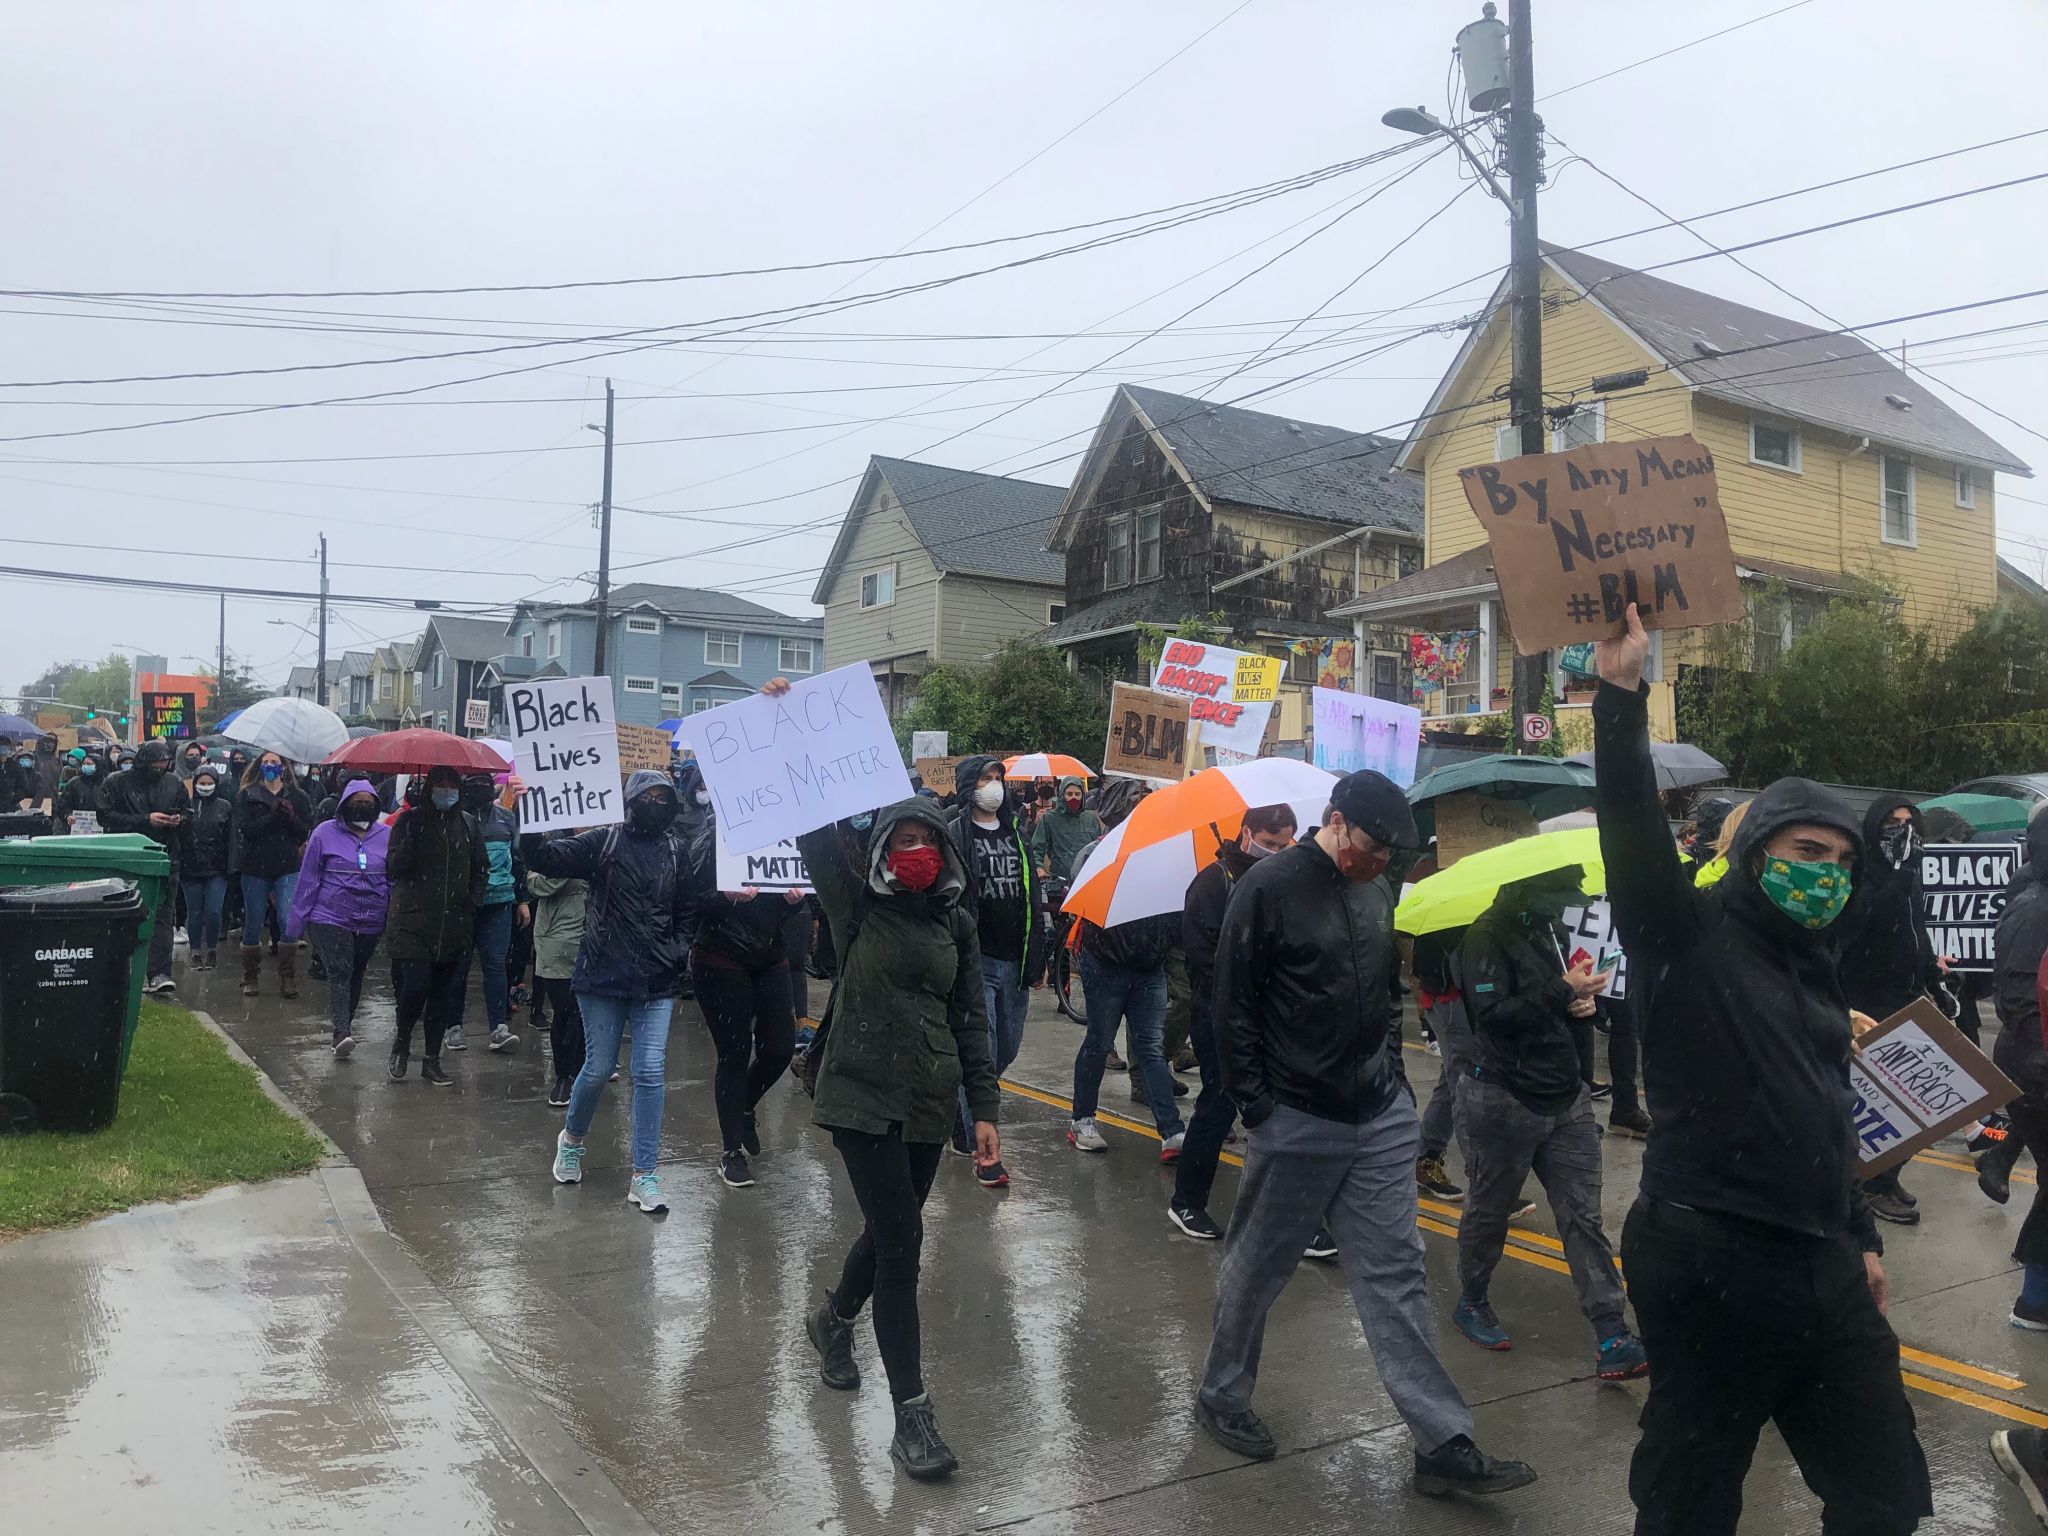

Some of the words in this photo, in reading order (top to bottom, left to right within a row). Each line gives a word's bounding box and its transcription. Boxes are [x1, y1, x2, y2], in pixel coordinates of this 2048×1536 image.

[1567, 460, 1629, 495] Any
[1567, 562, 1689, 624] #BLM
[1164, 641, 1206, 667] END
[1238, 657, 1267, 669] BLACK
[1157, 665, 1227, 697] RACIST
[1237, 672, 1262, 685] LIVES
[154, 696, 184, 708] BLACK
[1235, 688, 1272, 700] MATTER
[157, 710, 183, 723] LIVES
[511, 685, 601, 738] Black
[705, 680, 863, 764] BLACK
[151, 724, 189, 737] MATTER
[1112, 711, 1186, 764] #BLM
[532, 741, 602, 772] Lives
[714, 784, 783, 830] LIVES
[785, 745, 890, 807] MATTER
[973, 835, 1018, 857] BLAC
[746, 855, 811, 880] MATTE
[978, 856, 1019, 877] LIVE
[1922, 856, 2010, 886] BLACK
[1924, 892, 2007, 922] LIVES
[34, 947, 94, 961] GARBAGE
[1925, 927, 1996, 960] MATTE
[1915, 1043, 1936, 1059] I
[1931, 1060, 1955, 1078] AM
[1868, 1040, 1968, 1116] ANTI-RACIST
[1852, 1077, 1880, 1101] AND
[1881, 1104, 1893, 1113] I
